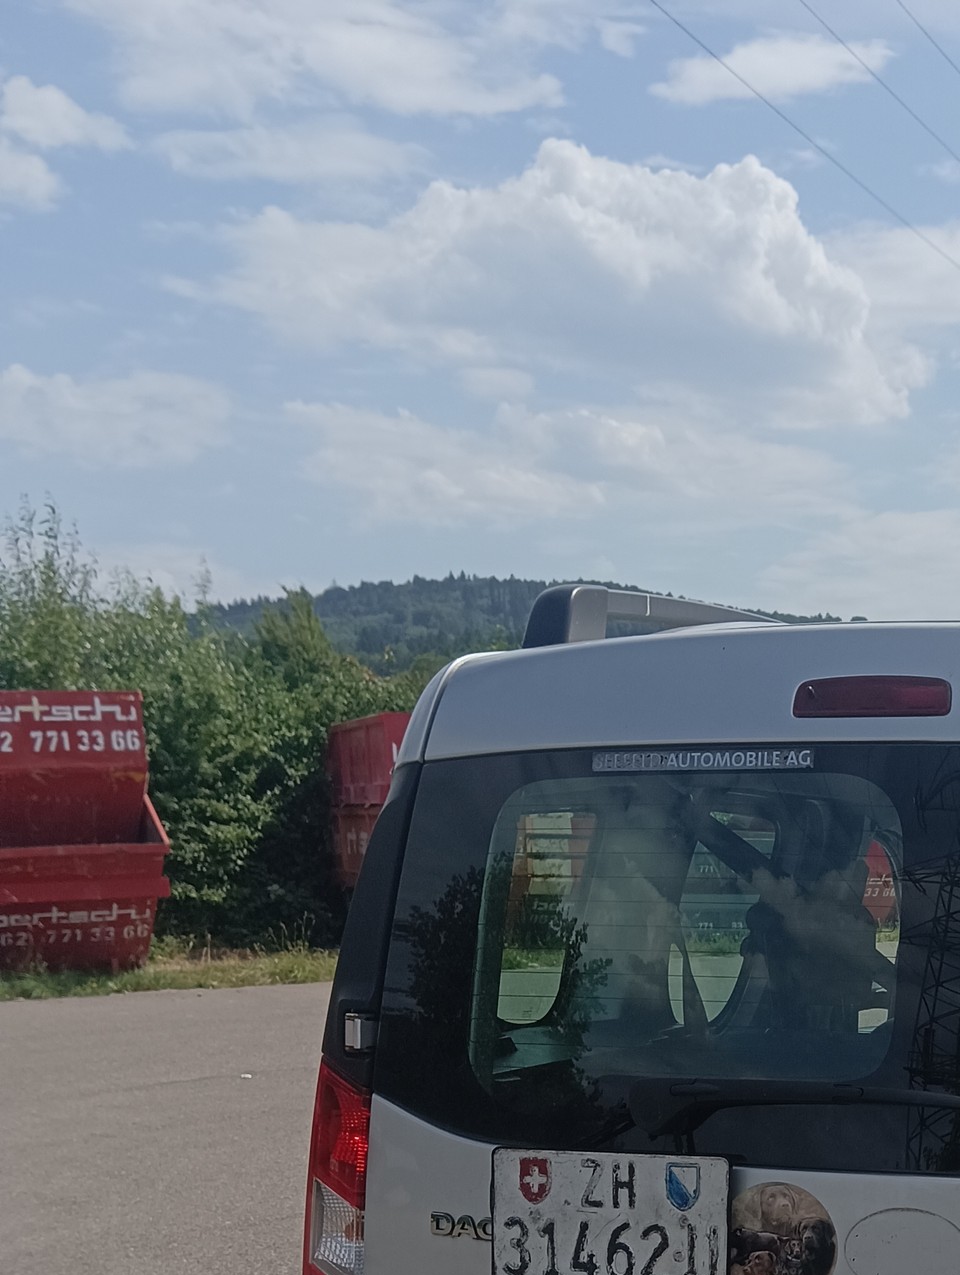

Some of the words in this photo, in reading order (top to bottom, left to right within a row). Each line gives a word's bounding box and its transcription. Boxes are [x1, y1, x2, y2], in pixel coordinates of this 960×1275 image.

[667, 751, 781, 768] AUTOMOBILE
[786, 750, 811, 766] AG
[581, 1158, 636, 1209] ZH
